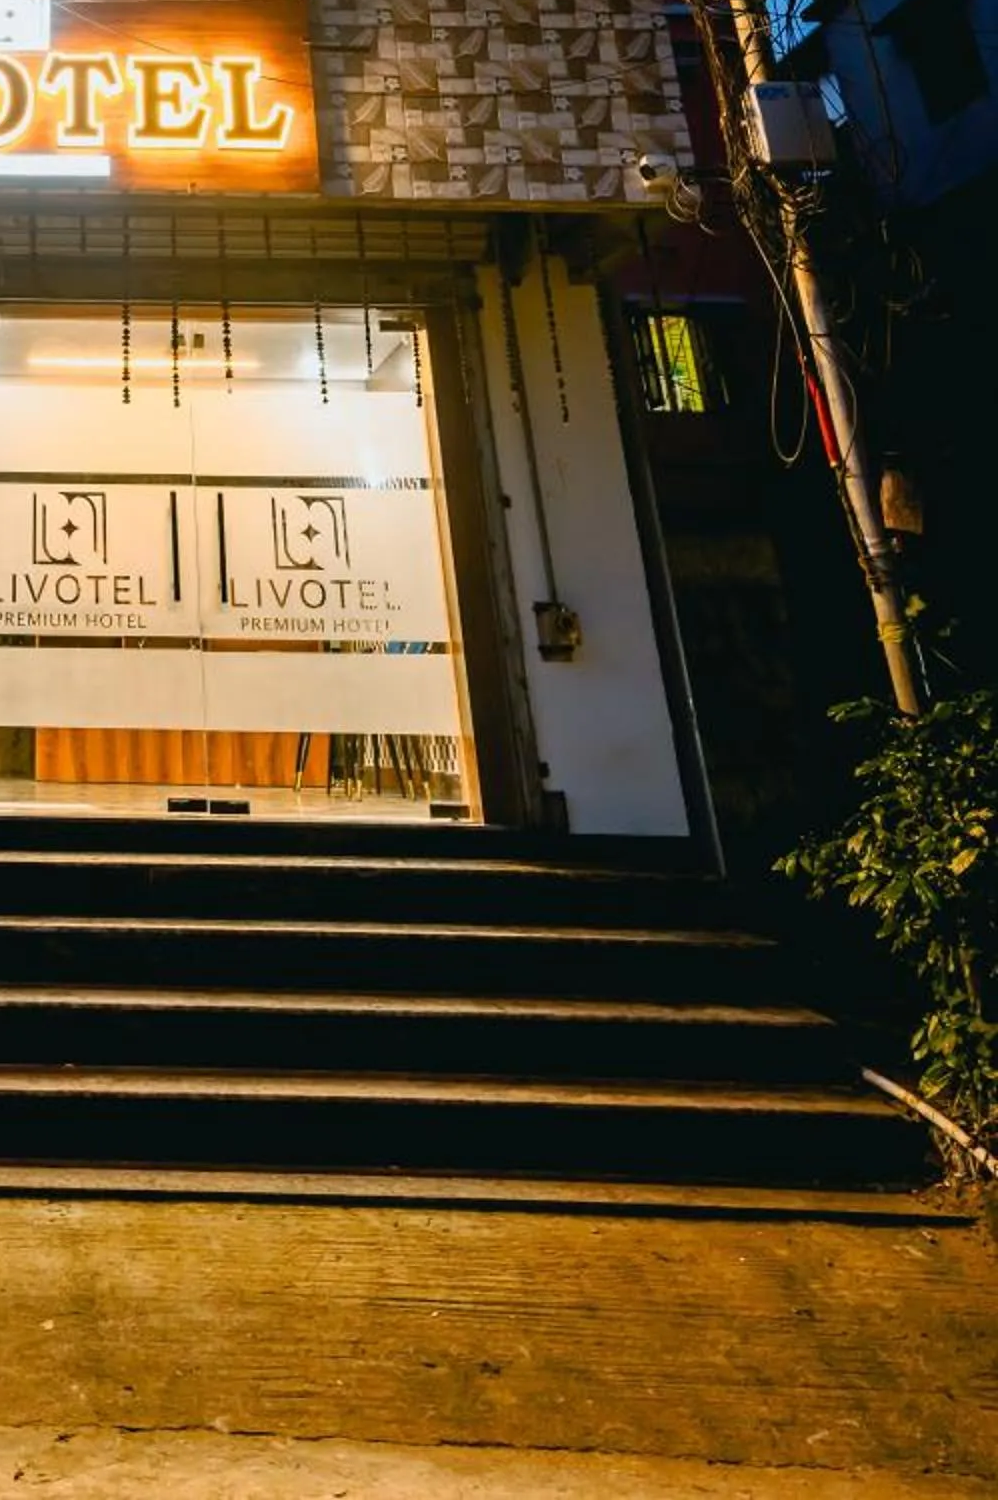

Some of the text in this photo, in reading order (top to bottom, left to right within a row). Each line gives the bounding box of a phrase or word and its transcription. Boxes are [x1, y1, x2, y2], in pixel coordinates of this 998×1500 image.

[230, 578, 401, 610] LIVOTEL
[85, 613, 147, 629] HOTEL
[240, 617, 325, 632] PREMIUM
